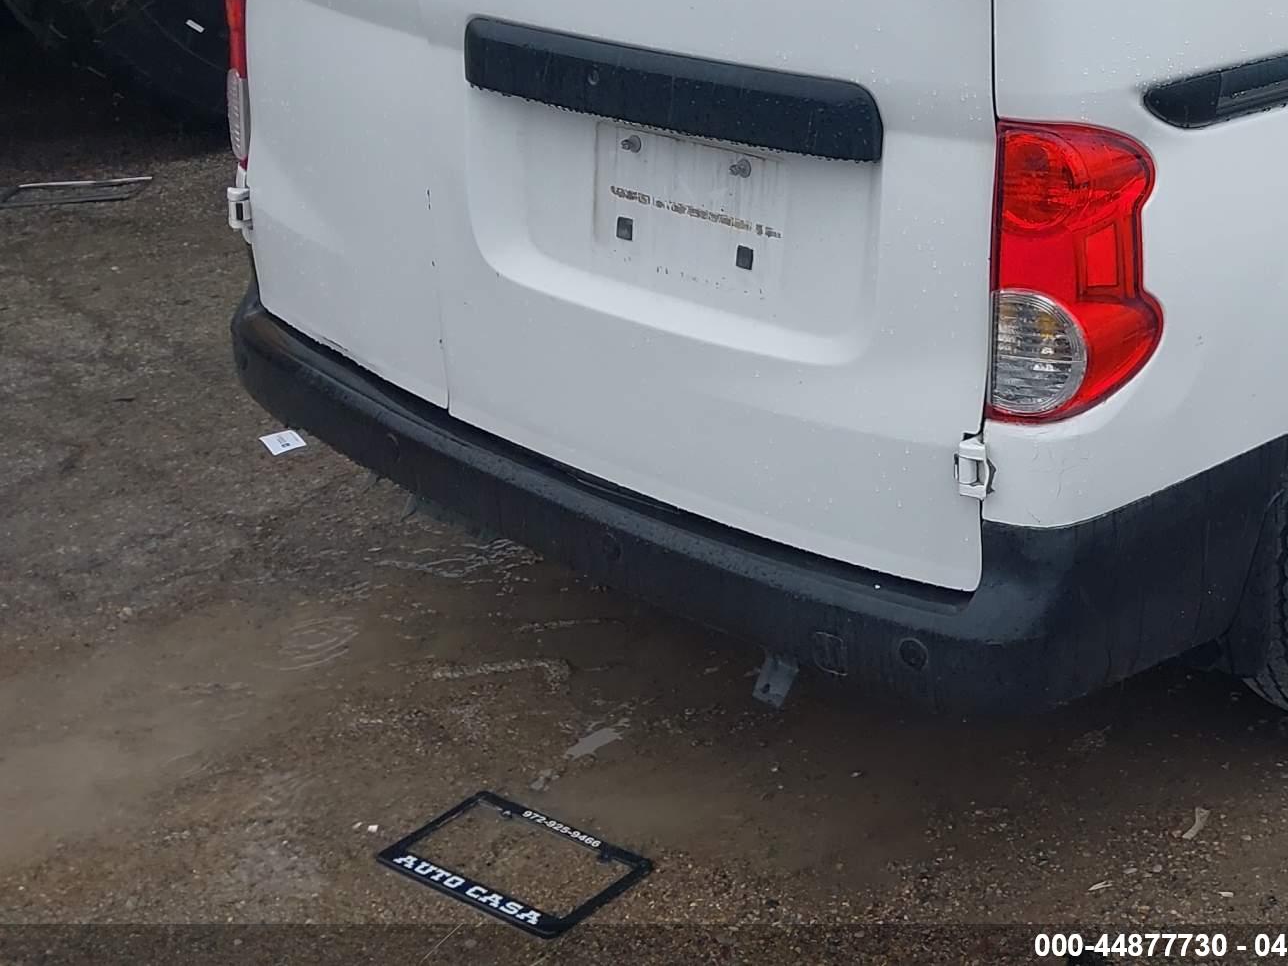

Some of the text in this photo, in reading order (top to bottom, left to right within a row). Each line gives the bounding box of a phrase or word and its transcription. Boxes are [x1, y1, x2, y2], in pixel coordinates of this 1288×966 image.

[521, 809, 601, 849] 972-925-9466
[392, 854, 544, 926] AUTO CASA
